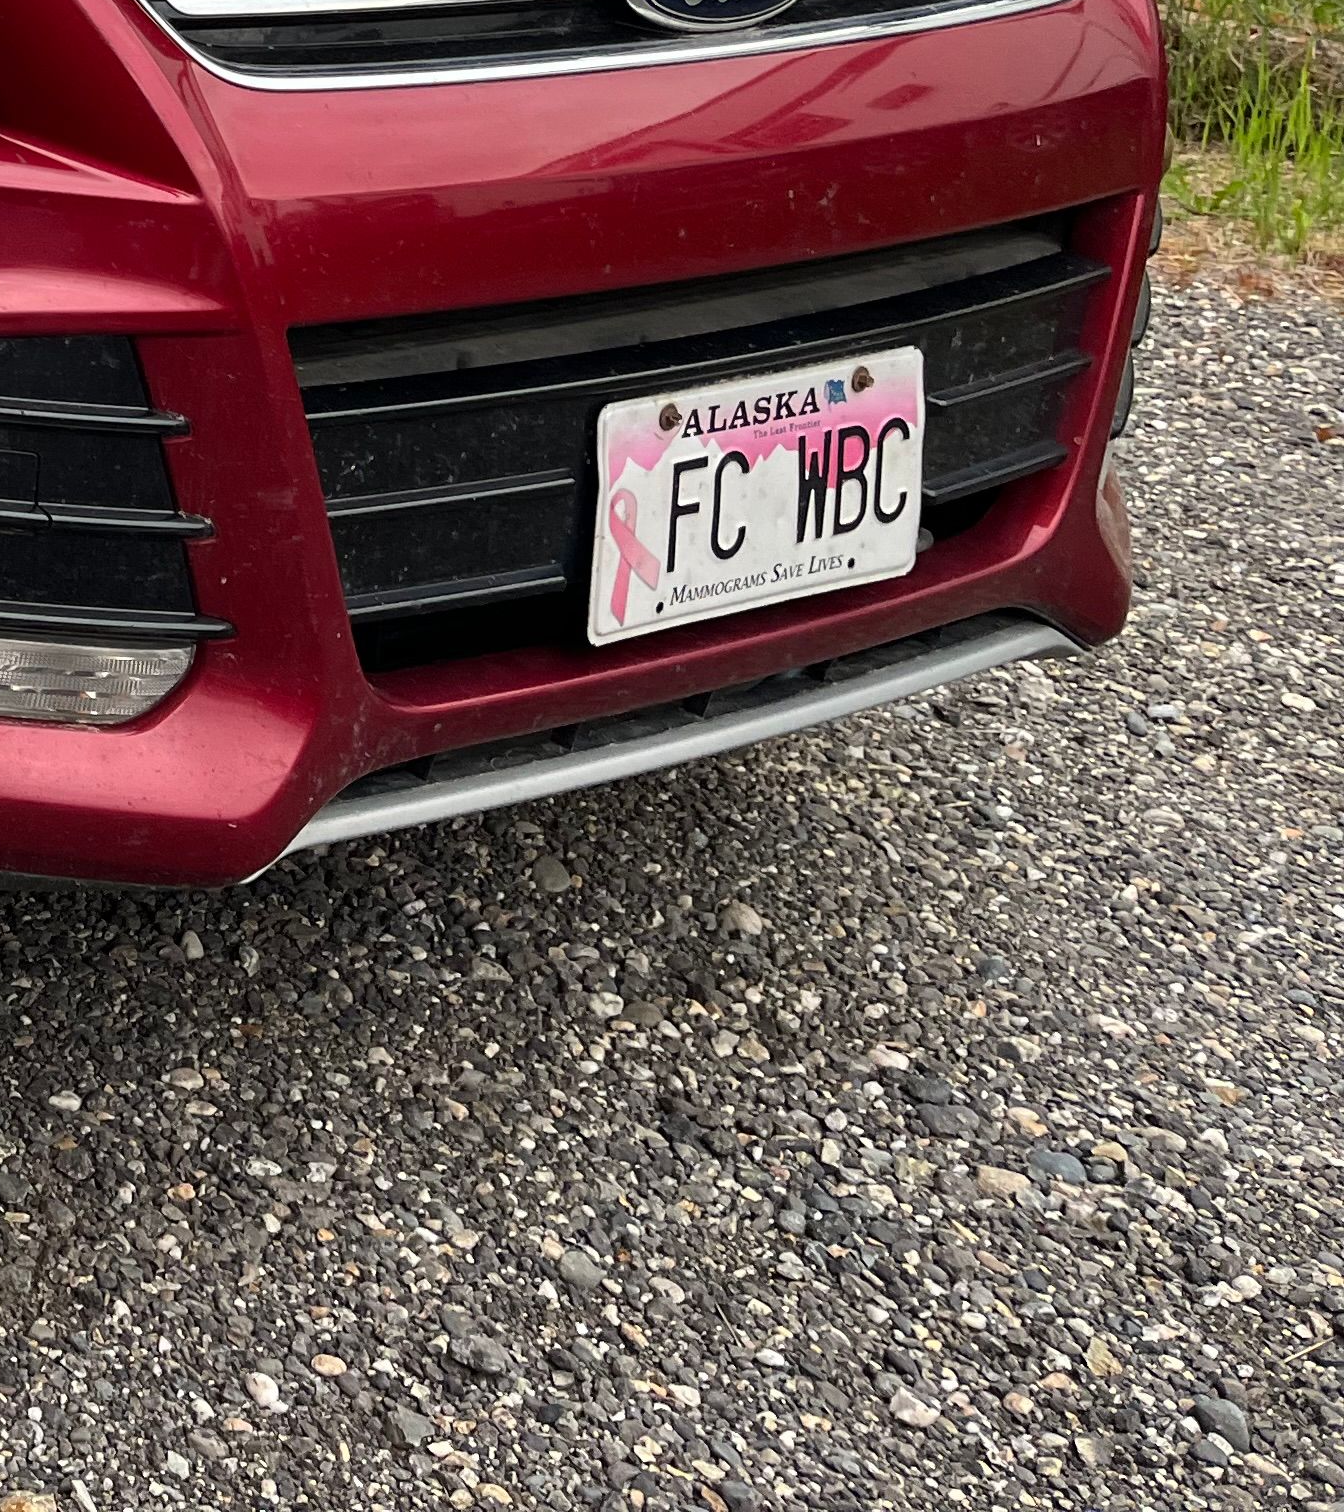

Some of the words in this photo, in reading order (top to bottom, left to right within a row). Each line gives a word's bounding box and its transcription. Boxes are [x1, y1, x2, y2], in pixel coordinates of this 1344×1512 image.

[681, 387, 820, 438] ALASKA
[753, 429, 768, 439] The
[666, 450, 750, 573] FC
[796, 417, 910, 543] WBC
[669, 571, 767, 606] MAMMOGRAMS
[771, 562, 805, 583] SAVE
[807, 554, 844, 575] LIVES
